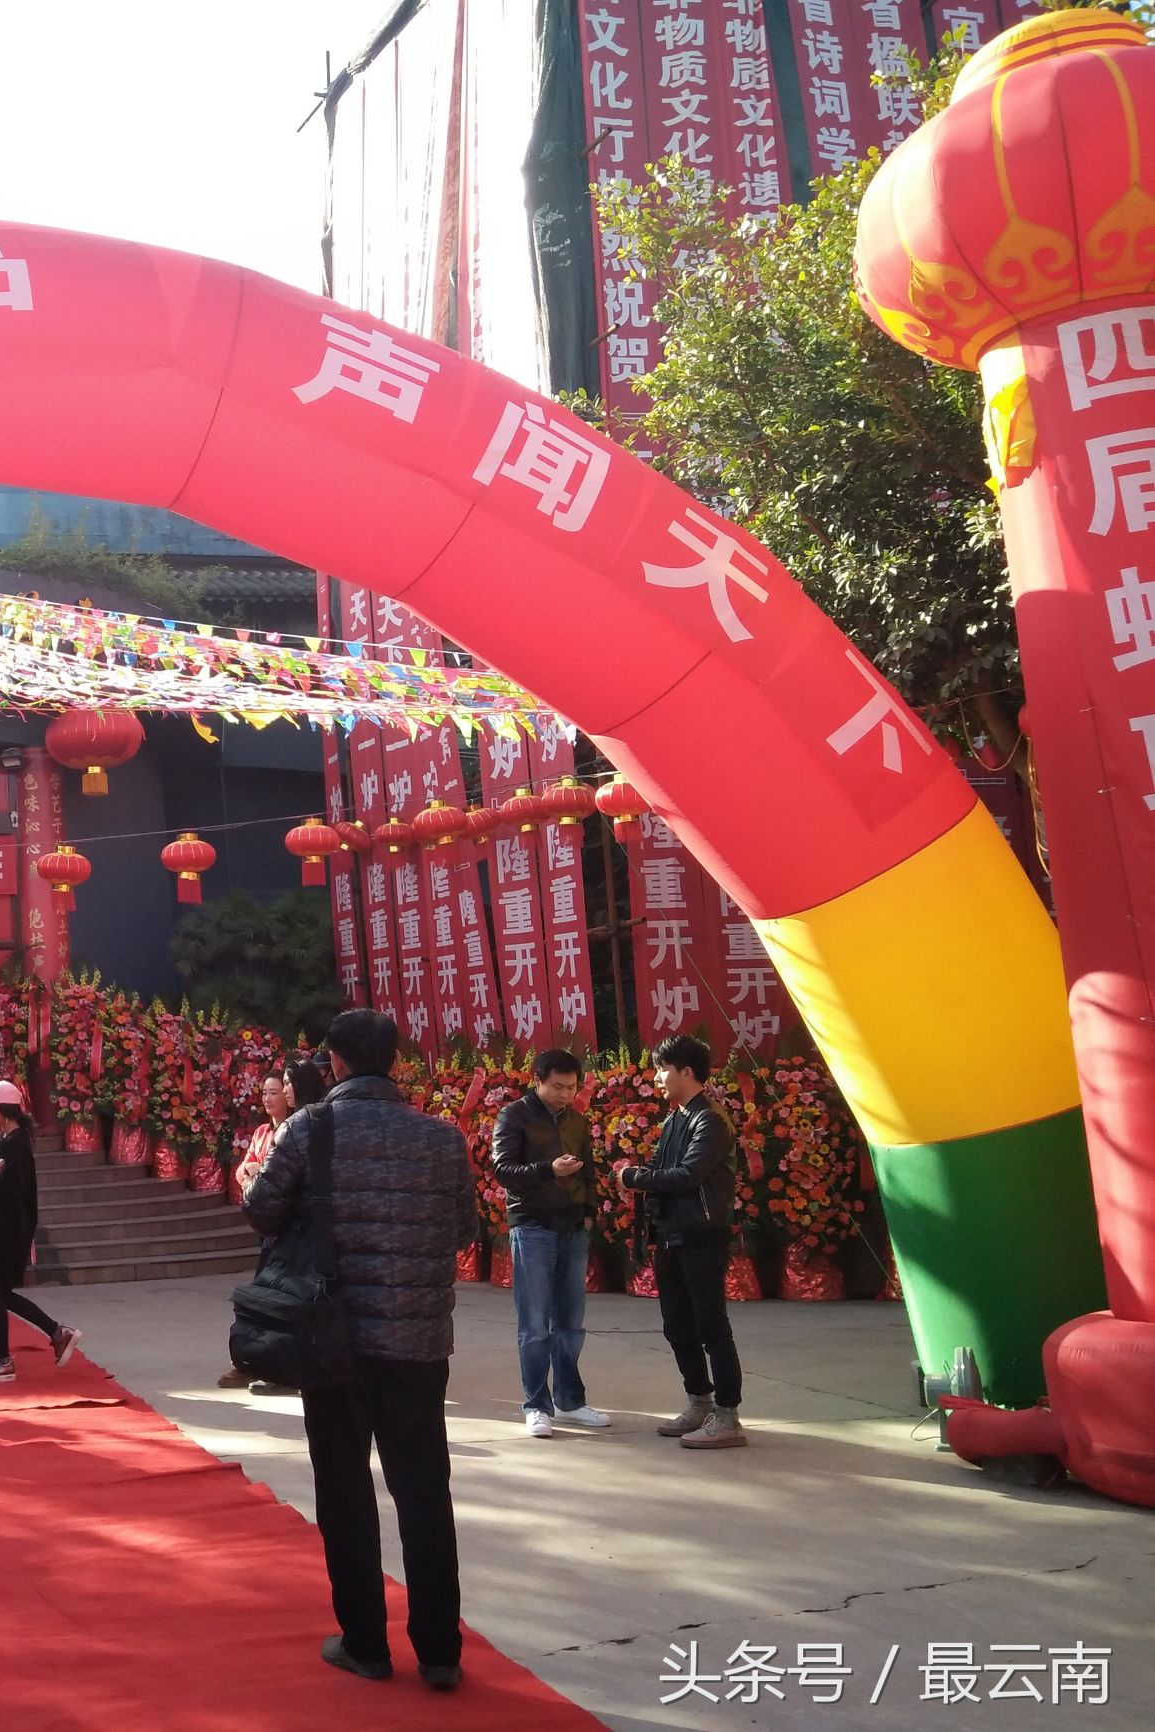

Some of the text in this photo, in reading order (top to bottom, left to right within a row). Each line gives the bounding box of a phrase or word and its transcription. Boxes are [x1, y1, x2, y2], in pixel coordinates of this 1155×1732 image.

[585, 0, 649, 384] 文化厅热烈祝贺
[292, 312, 933, 774] 声闻天下
[396, 862, 430, 1043] 隆重开炉
[496, 835, 543, 1041] 隆重开炉
[546, 823, 588, 1036] 隆重开炉
